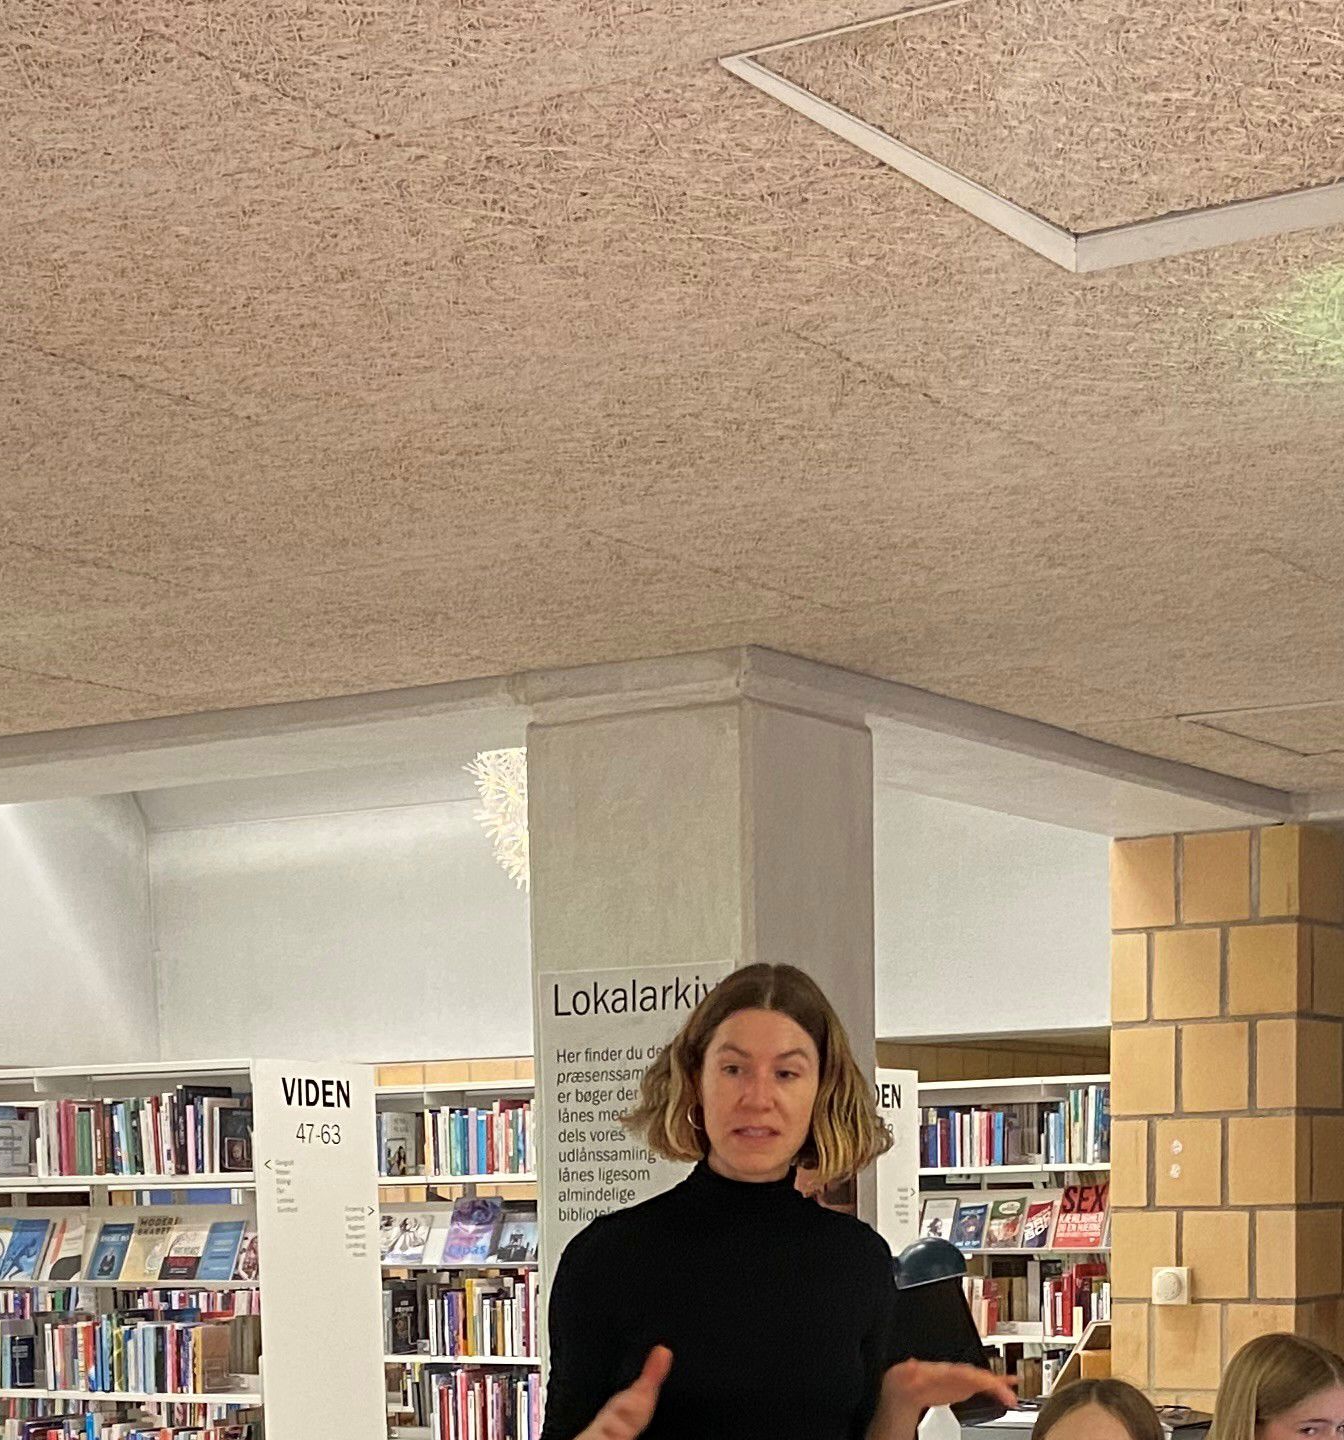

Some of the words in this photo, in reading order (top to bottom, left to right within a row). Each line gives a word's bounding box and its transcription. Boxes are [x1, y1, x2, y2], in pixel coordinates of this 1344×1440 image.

[556, 1049, 581, 1064] Her
[584, 1047, 624, 1062] finder
[626, 1046, 643, 1060] du
[281, 1077, 351, 1108] VIDEN
[557, 1091, 572, 1104] er
[575, 1088, 613, 1106] bøger
[558, 1108, 594, 1123] lånes
[295, 1123, 342, 1145] 47-63
[558, 1128, 586, 1143] dels
[590, 1129, 626, 1142] vores
[558, 1146, 656, 1164] udlånssamling
[558, 1167, 594, 1182] lånes
[598, 1167, 650, 1184] ligesom
[558, 1186, 636, 1204] almindelige
[1062, 1185, 1107, 1213] SEX
